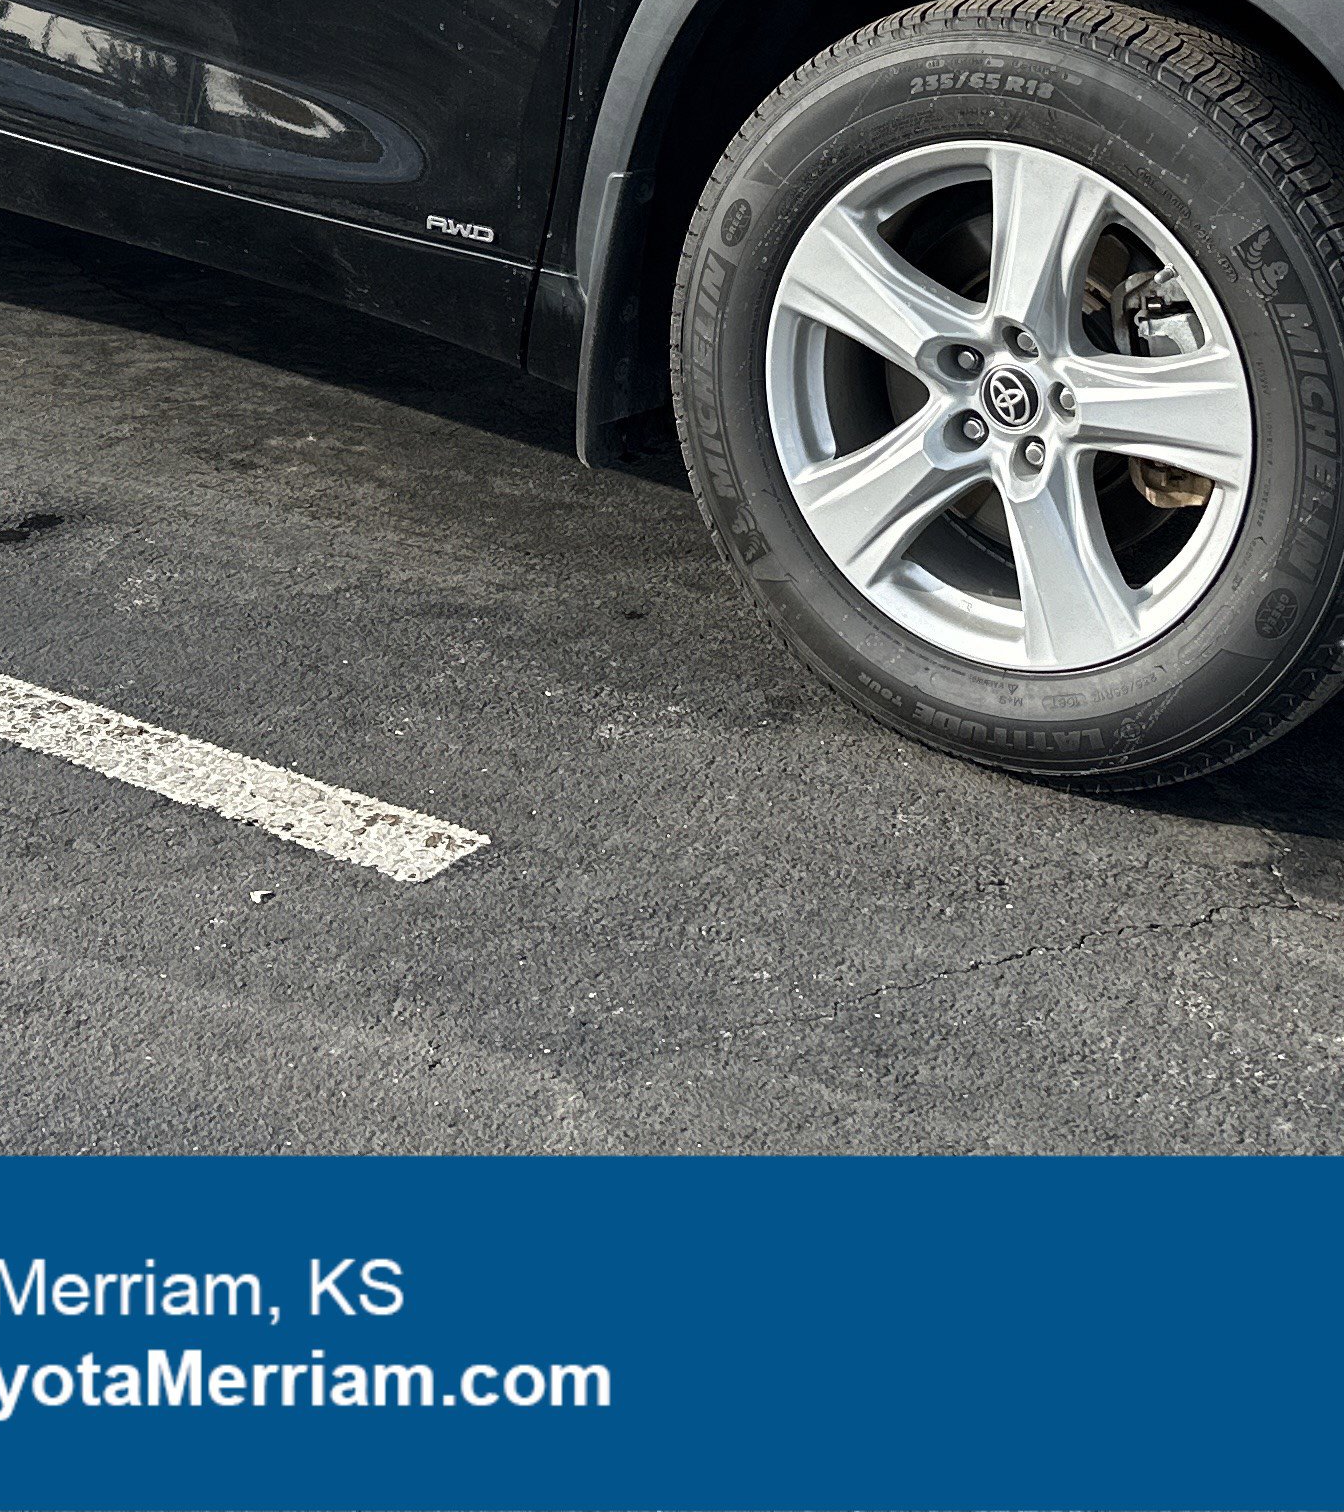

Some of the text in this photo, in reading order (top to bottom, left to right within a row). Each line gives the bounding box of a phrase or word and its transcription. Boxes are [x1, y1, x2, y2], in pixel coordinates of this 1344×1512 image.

[910, 73, 1000, 94] 235/65
[1006, 76, 1055, 98] R18
[426, 215, 494, 243] AWD
[726, 203, 748, 242] GREEN
[690, 256, 738, 498] MICHELIN
[1275, 303, 1341, 583] MICHELIN
[858, 672, 1105, 751] LATITUDE TOUR
